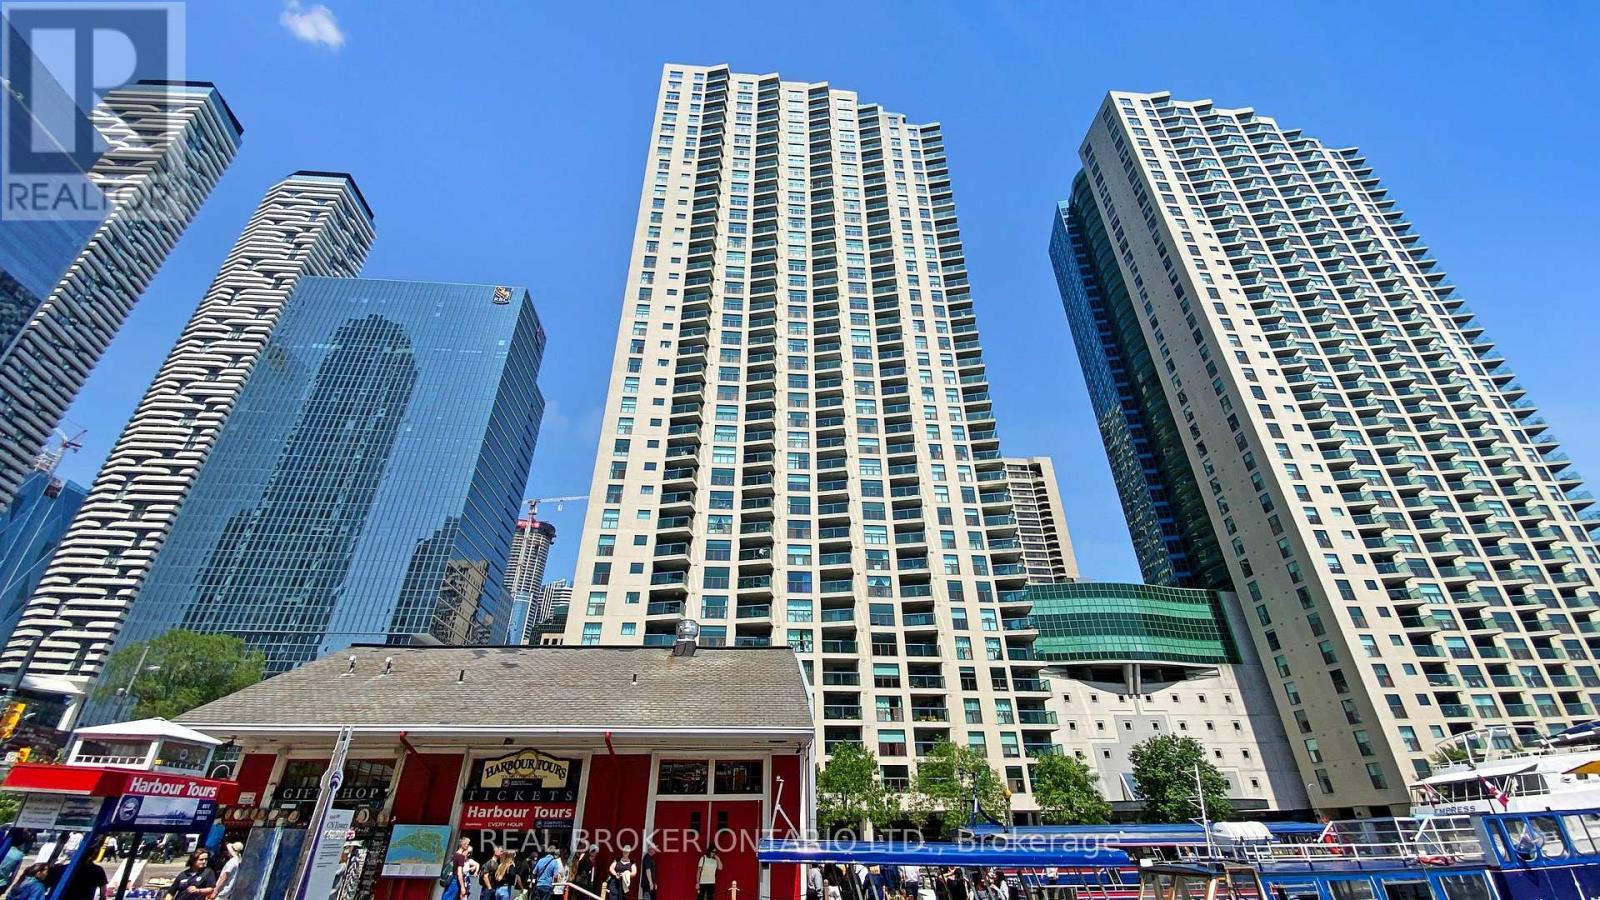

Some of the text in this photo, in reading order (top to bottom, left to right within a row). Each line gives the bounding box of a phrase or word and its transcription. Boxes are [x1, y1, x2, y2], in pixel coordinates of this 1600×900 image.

[485, 759, 567, 780] HARBOUR TOURS
[129, 777, 217, 798] Harbour Tours
[335, 788, 379, 800] HOP
[468, 790, 574, 801] TICKETS
[467, 805, 573, 818] Harbour Tours
[1434, 805, 1476, 816] EMPRESS
